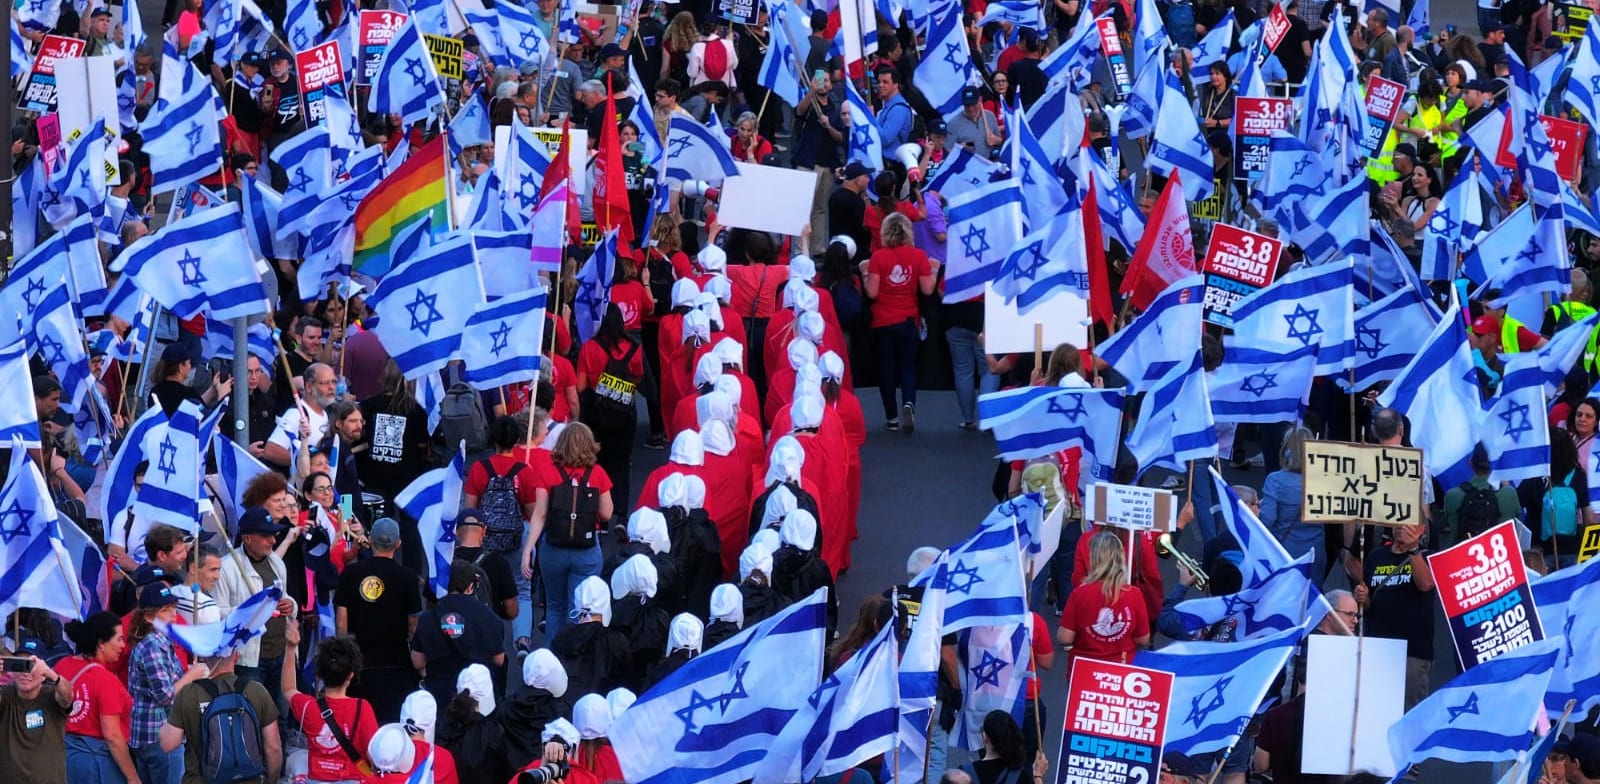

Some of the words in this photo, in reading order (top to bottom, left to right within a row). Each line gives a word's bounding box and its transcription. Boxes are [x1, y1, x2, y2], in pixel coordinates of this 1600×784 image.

[315, 46, 336, 67] 3.8
[424, 36, 461, 56] ממשל
[304, 64, 338, 84] תוספת
[1259, 101, 1284, 119] 3.8
[1238, 236, 1272, 264] 3.8
[1213, 250, 1268, 276] תוספת
[1384, 494, 1411, 522] על
[1468, 534, 1508, 574] 3.8
[1454, 560, 1513, 600] תוספת
[1463, 588, 1522, 628] במקום
[1480, 604, 1526, 640] 2,100
[1504, 620, 1530, 641] תוספת
[1473, 636, 1502, 652] לשכר
[1093, 672, 1122, 684] מיליוני
[1123, 672, 1152, 698] 6
[1080, 690, 1124, 706] והדרכה
[1076, 700, 1158, 728] לטהרת
[1074, 717, 1156, 742] המשפחה
[1070, 734, 1152, 764] במקום
[1068, 754, 1128, 774] מקלטים
[1068, 766, 1094, 778] לנשים
[1128, 766, 1149, 784] 2
